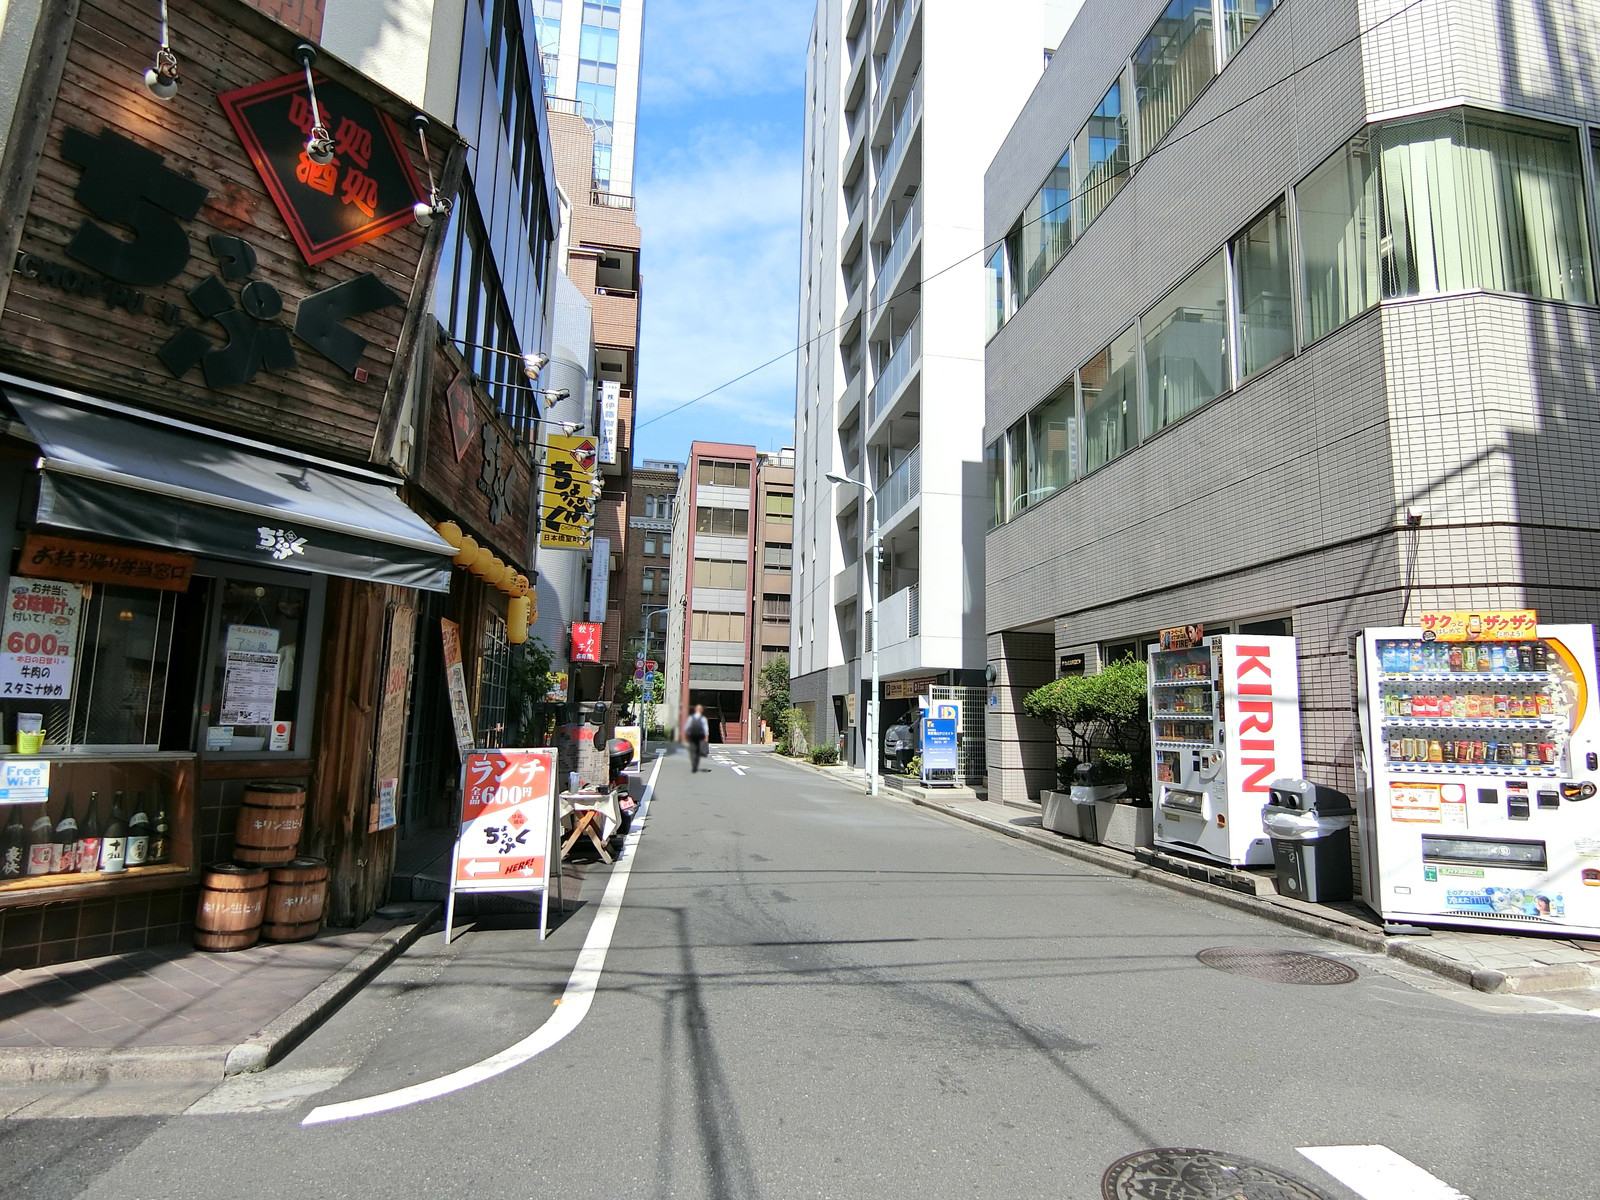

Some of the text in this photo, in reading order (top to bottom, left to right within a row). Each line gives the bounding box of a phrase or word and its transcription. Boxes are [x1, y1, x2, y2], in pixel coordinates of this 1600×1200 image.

[31, 547, 187, 580] お持ち帰り弁当窓口
[31, 583, 68, 596] お弁当に
[1483, 614, 1537, 631] ザクザク
[7, 631, 70, 656] 600円
[586, 625, 595, 652] らーめん
[21, 665, 51, 679] 牛肉の
[3, 682, 63, 697] スタミナ炒め
[1235, 644, 1276, 793] KIRIN
[6, 766, 41, 777] Free
[470, 757, 546, 786] ランチ
[7, 776, 41, 787] Wi-Fi
[504, 858, 535, 875] HERE!
